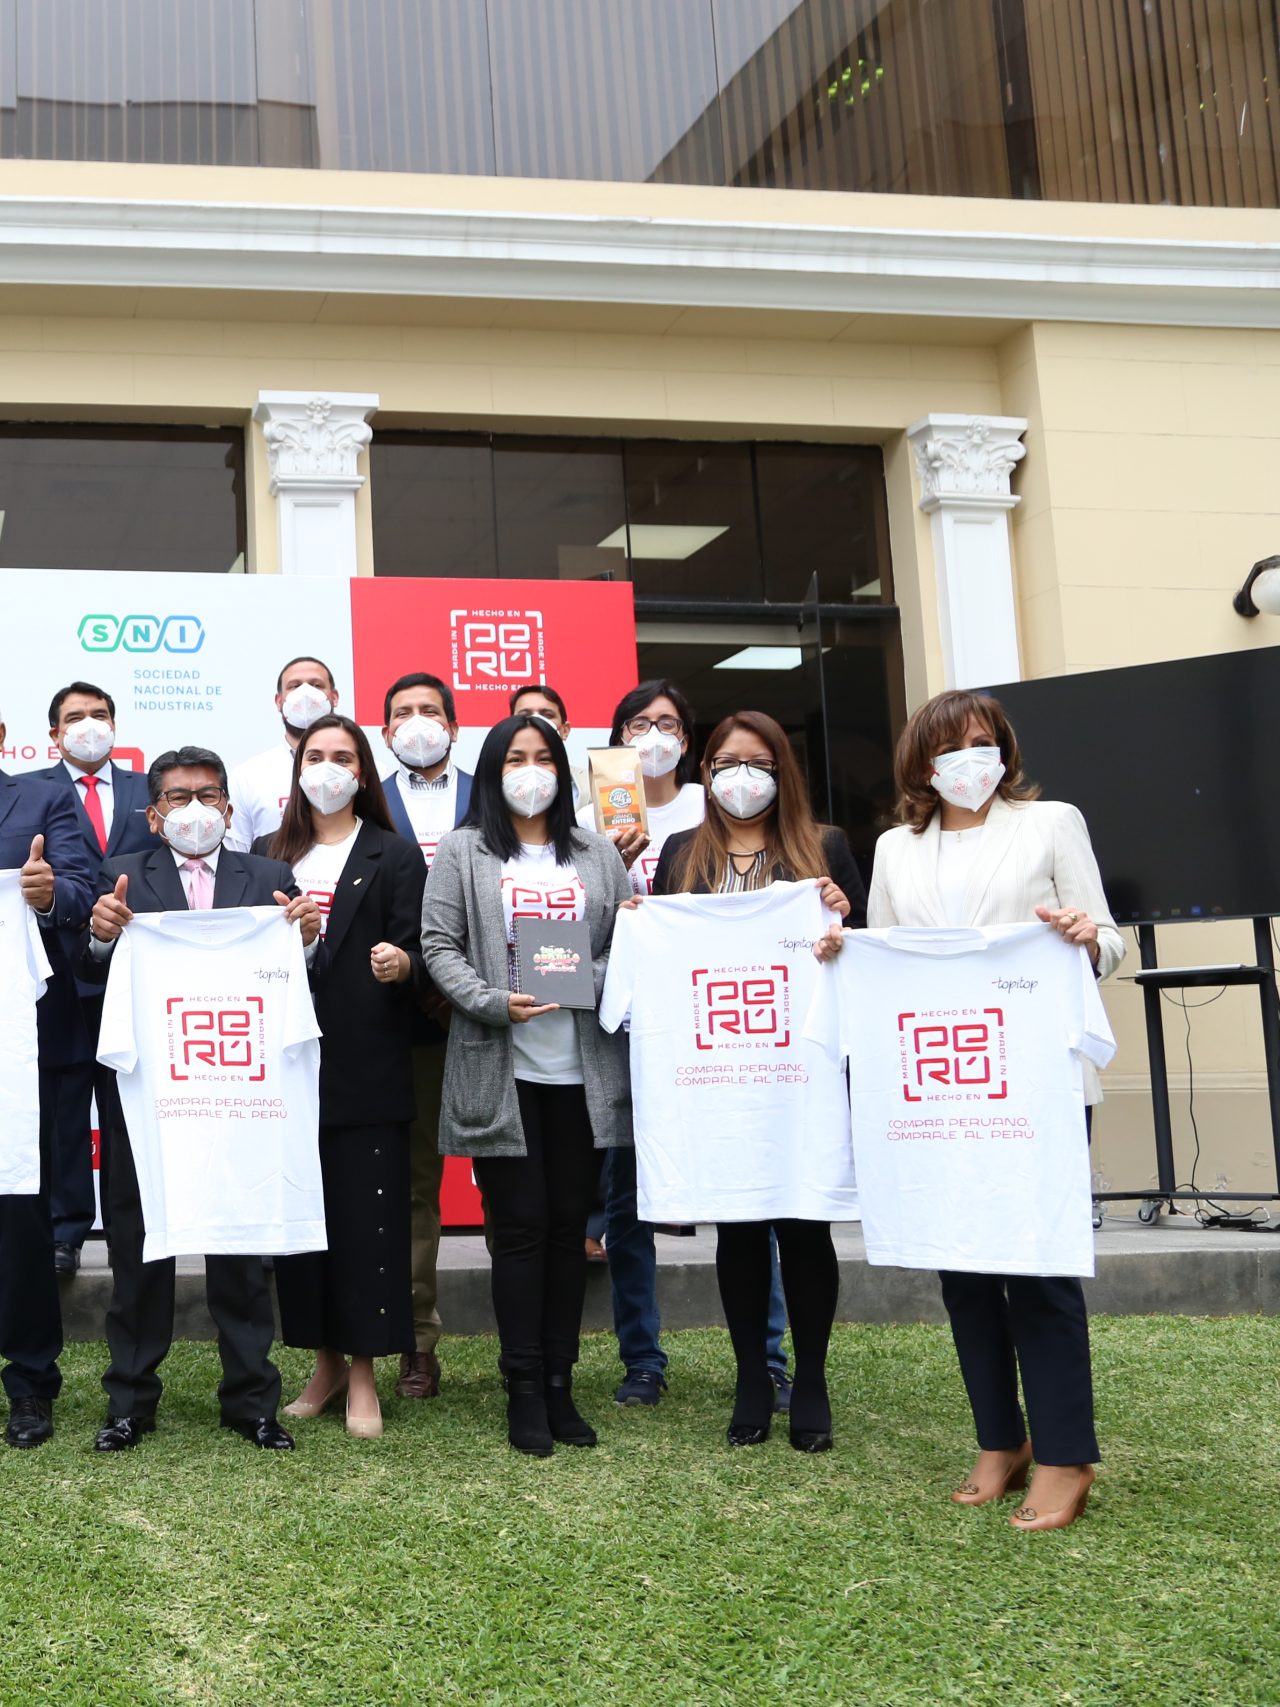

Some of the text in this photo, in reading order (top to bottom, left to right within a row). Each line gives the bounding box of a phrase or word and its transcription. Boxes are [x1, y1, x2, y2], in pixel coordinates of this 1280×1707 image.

[92, 624, 185, 643] SNI
[451, 630, 458, 640] IN
[537, 632, 545, 670] MADE IN
[133, 669, 201, 680] SOCIEDAD
[134, 685, 223, 695] NACIONAL DE
[133, 701, 214, 711] INDUSTRIAS
[693, 990, 699, 1000] IN
[921, 1009, 958, 1017] HECHO
[167, 1019, 173, 1028] IN
[784, 1016, 790, 1025] IN
[259, 1049, 265, 1059] IN
[899, 1037, 908, 1079] MADE IN
[998, 1031, 1007, 1075] MADE IN
[676, 1065, 733, 1075] COMPRA
[754, 1075, 771, 1084] AL
[229, 1110, 246, 1119] AL
[889, 1119, 944, 1129] COMPRA
[964, 1130, 984, 1140] AL
